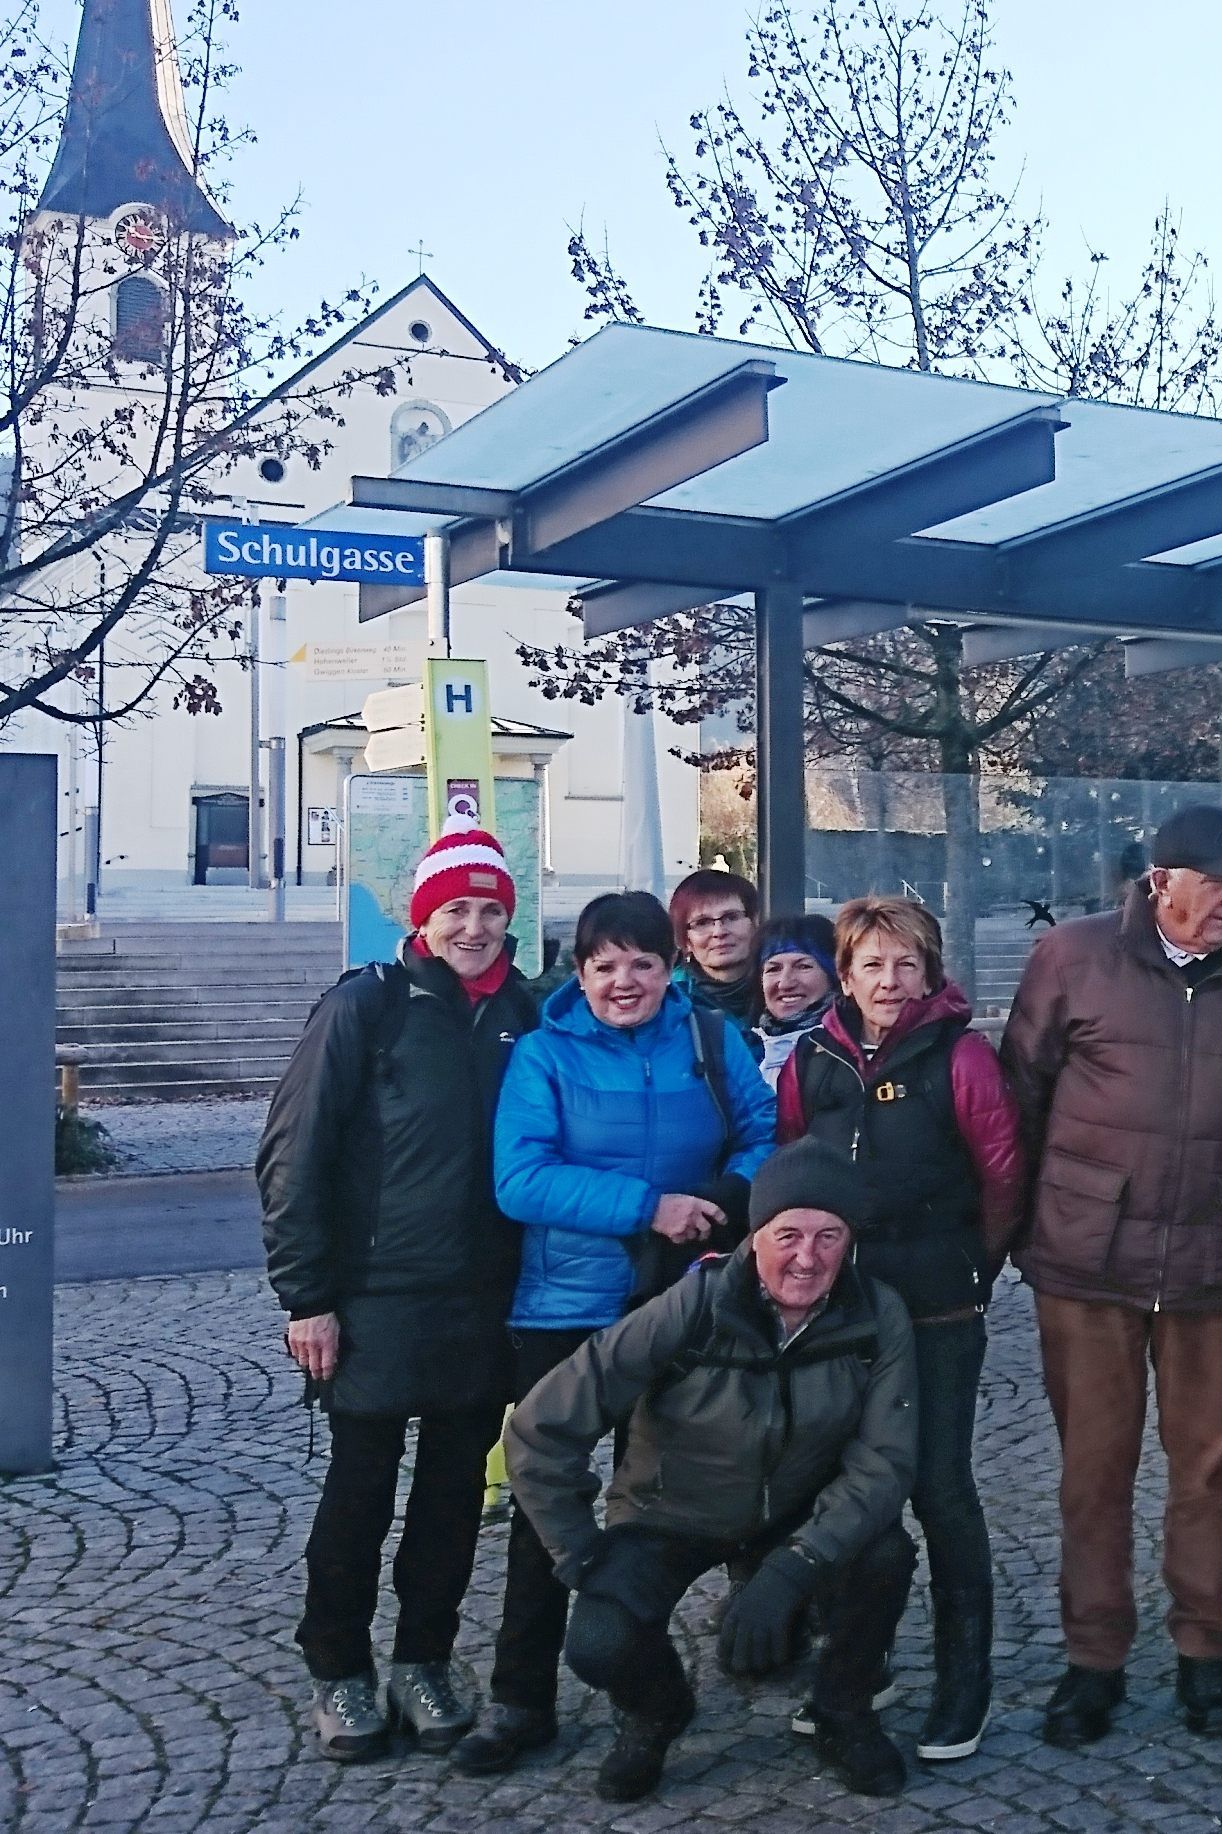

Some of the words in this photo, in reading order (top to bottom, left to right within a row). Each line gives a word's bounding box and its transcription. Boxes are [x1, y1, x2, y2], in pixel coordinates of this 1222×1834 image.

[217, 531, 415, 577] Schulgasse
[445, 684, 473, 713] H
[0, 1227, 33, 1245] Uhr
